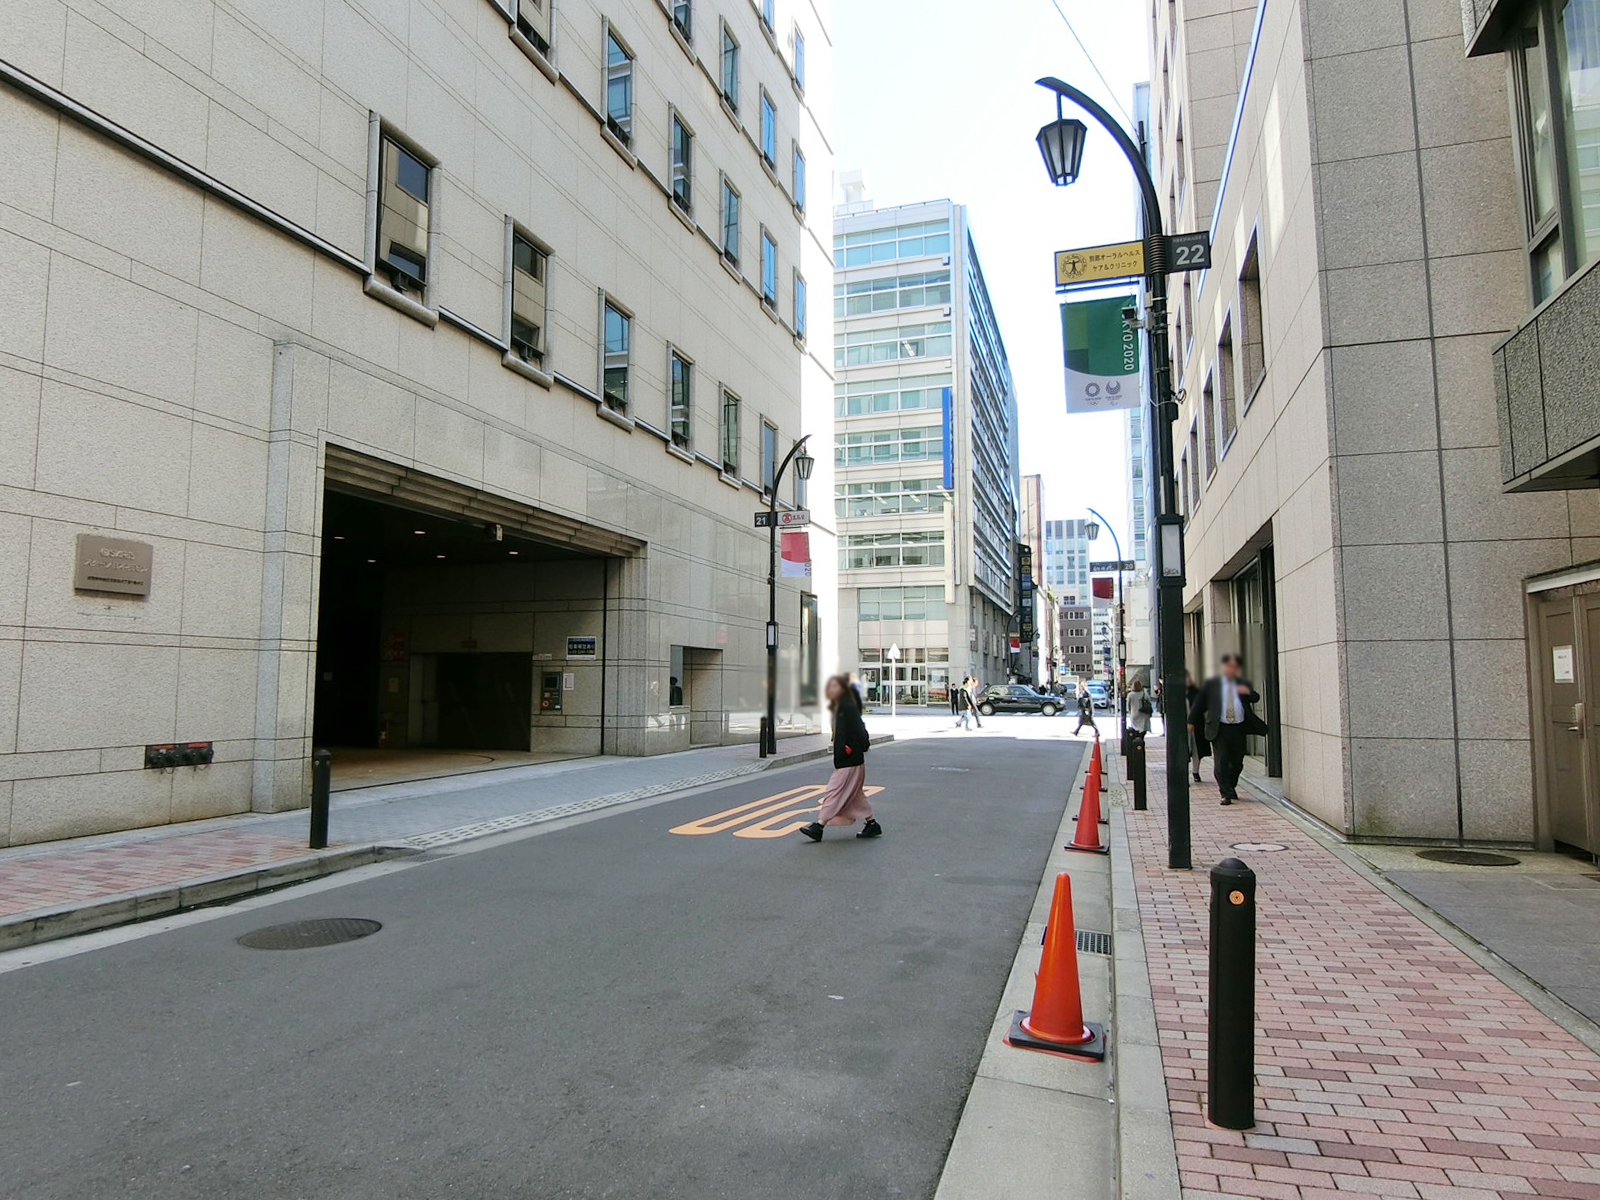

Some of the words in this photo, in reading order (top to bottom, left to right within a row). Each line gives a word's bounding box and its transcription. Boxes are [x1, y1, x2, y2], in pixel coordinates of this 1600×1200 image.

[1176, 244, 1205, 265] 22
[1121, 304, 1133, 342] TKYO
[1123, 343, 1135, 371] 2020
[756, 517, 766, 526] 21
